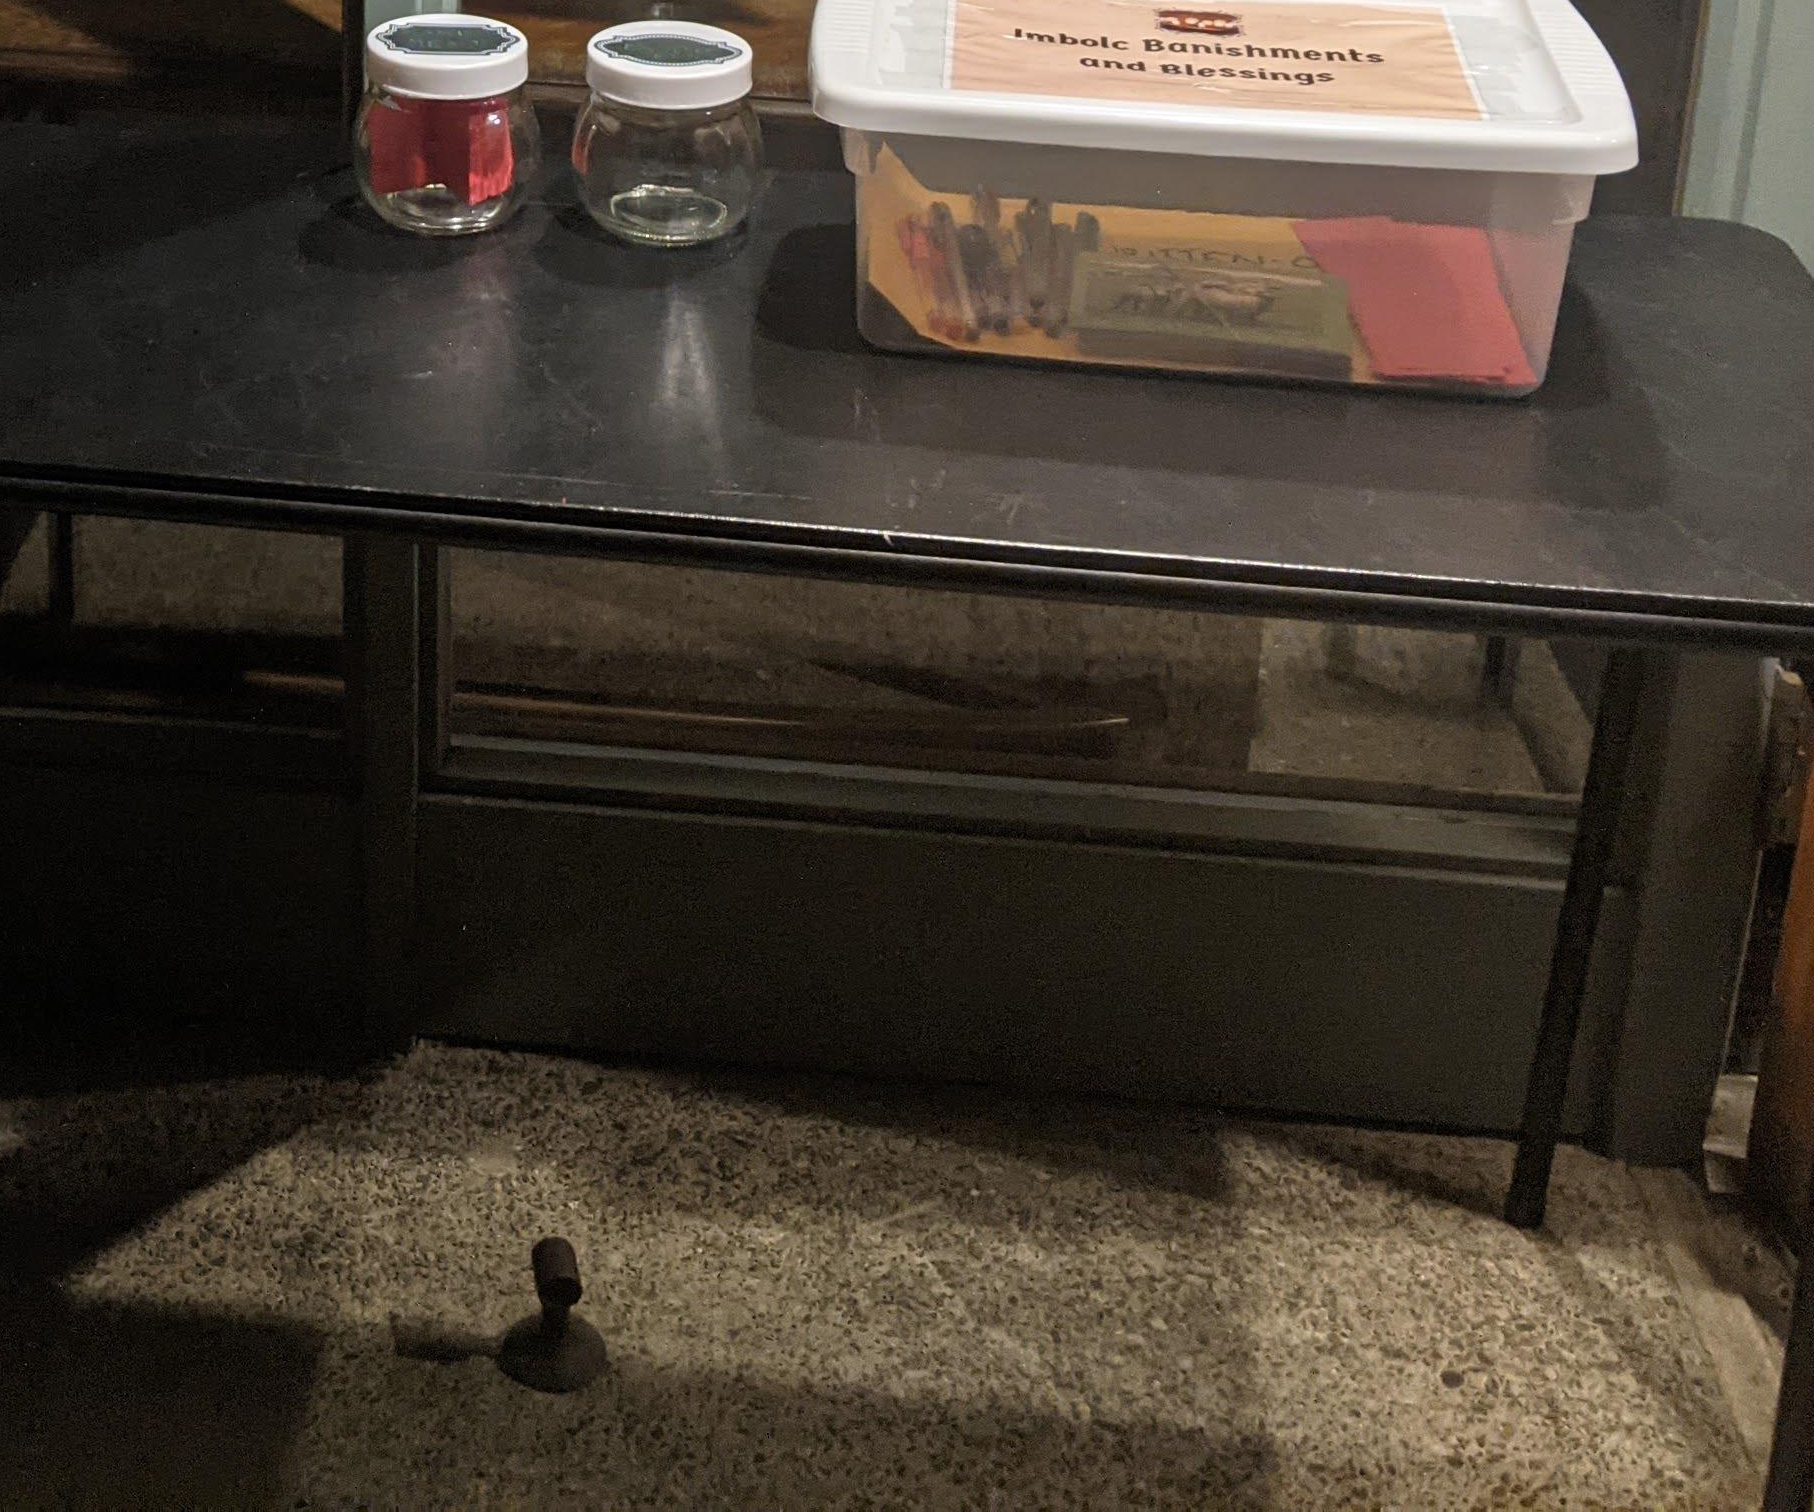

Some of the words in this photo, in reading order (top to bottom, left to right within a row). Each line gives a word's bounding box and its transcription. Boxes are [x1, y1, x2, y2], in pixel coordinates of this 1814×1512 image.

[1014, 28, 1130, 51] Imbolc
[1142, 39, 1385, 64] Banishments
[1079, 57, 1147, 73] and
[1158, 63, 1335, 87] Blessings
